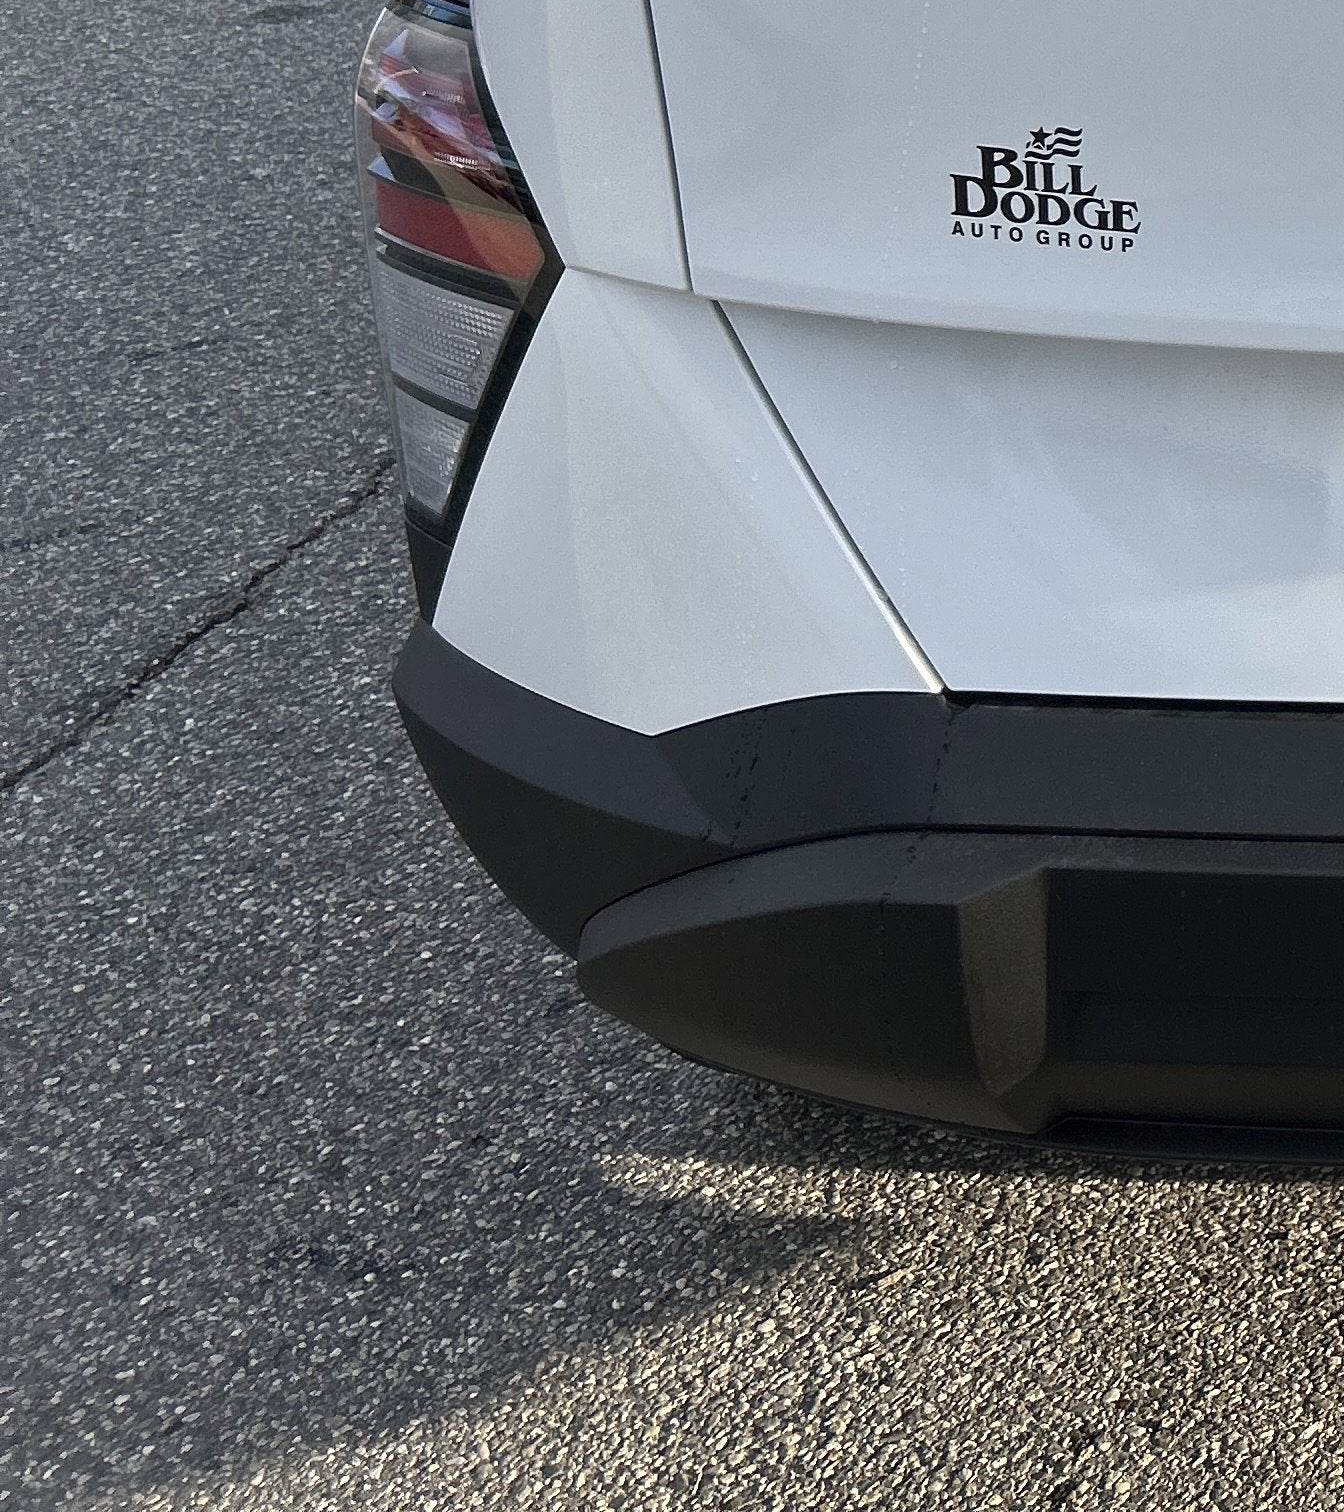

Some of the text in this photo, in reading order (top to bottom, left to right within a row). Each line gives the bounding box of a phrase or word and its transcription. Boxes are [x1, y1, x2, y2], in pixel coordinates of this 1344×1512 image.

[976, 145, 1098, 197] BILL
[949, 173, 1142, 234] DODGE
[951, 220, 1134, 253] AUTO GROUP
